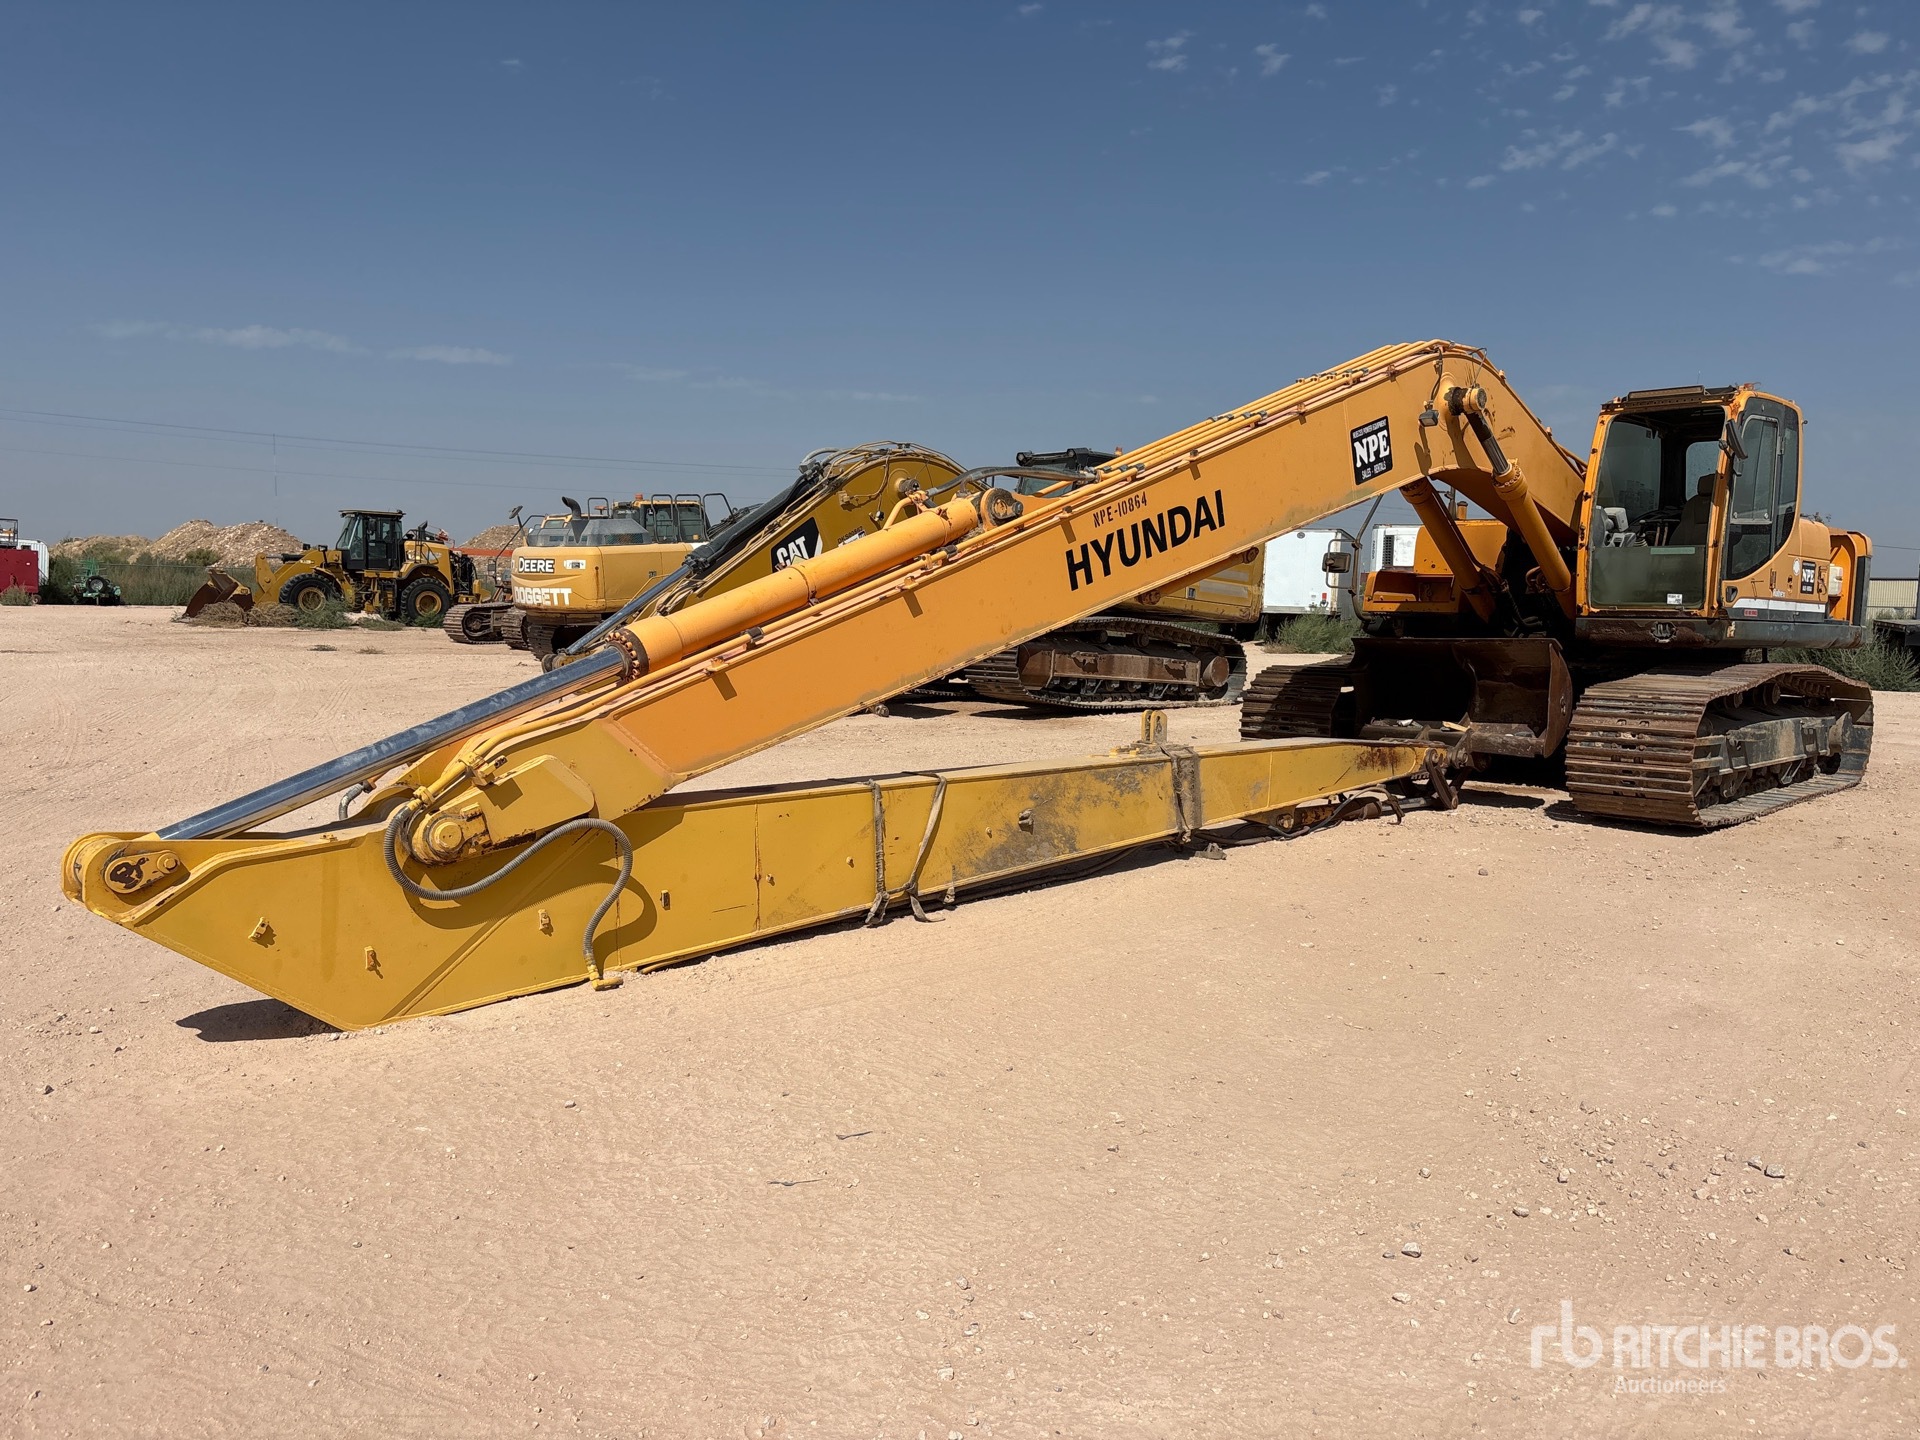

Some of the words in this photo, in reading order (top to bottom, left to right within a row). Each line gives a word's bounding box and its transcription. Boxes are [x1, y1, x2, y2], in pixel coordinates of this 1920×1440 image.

[1353, 429, 1390, 468] NPE
[1093, 491, 1147, 528] NPE-10864
[776, 535, 810, 567] CAT
[1065, 489, 1226, 592] HYUNDAI
[518, 556, 555, 573] DEERE
[514, 586, 572, 606] DOGGETT
